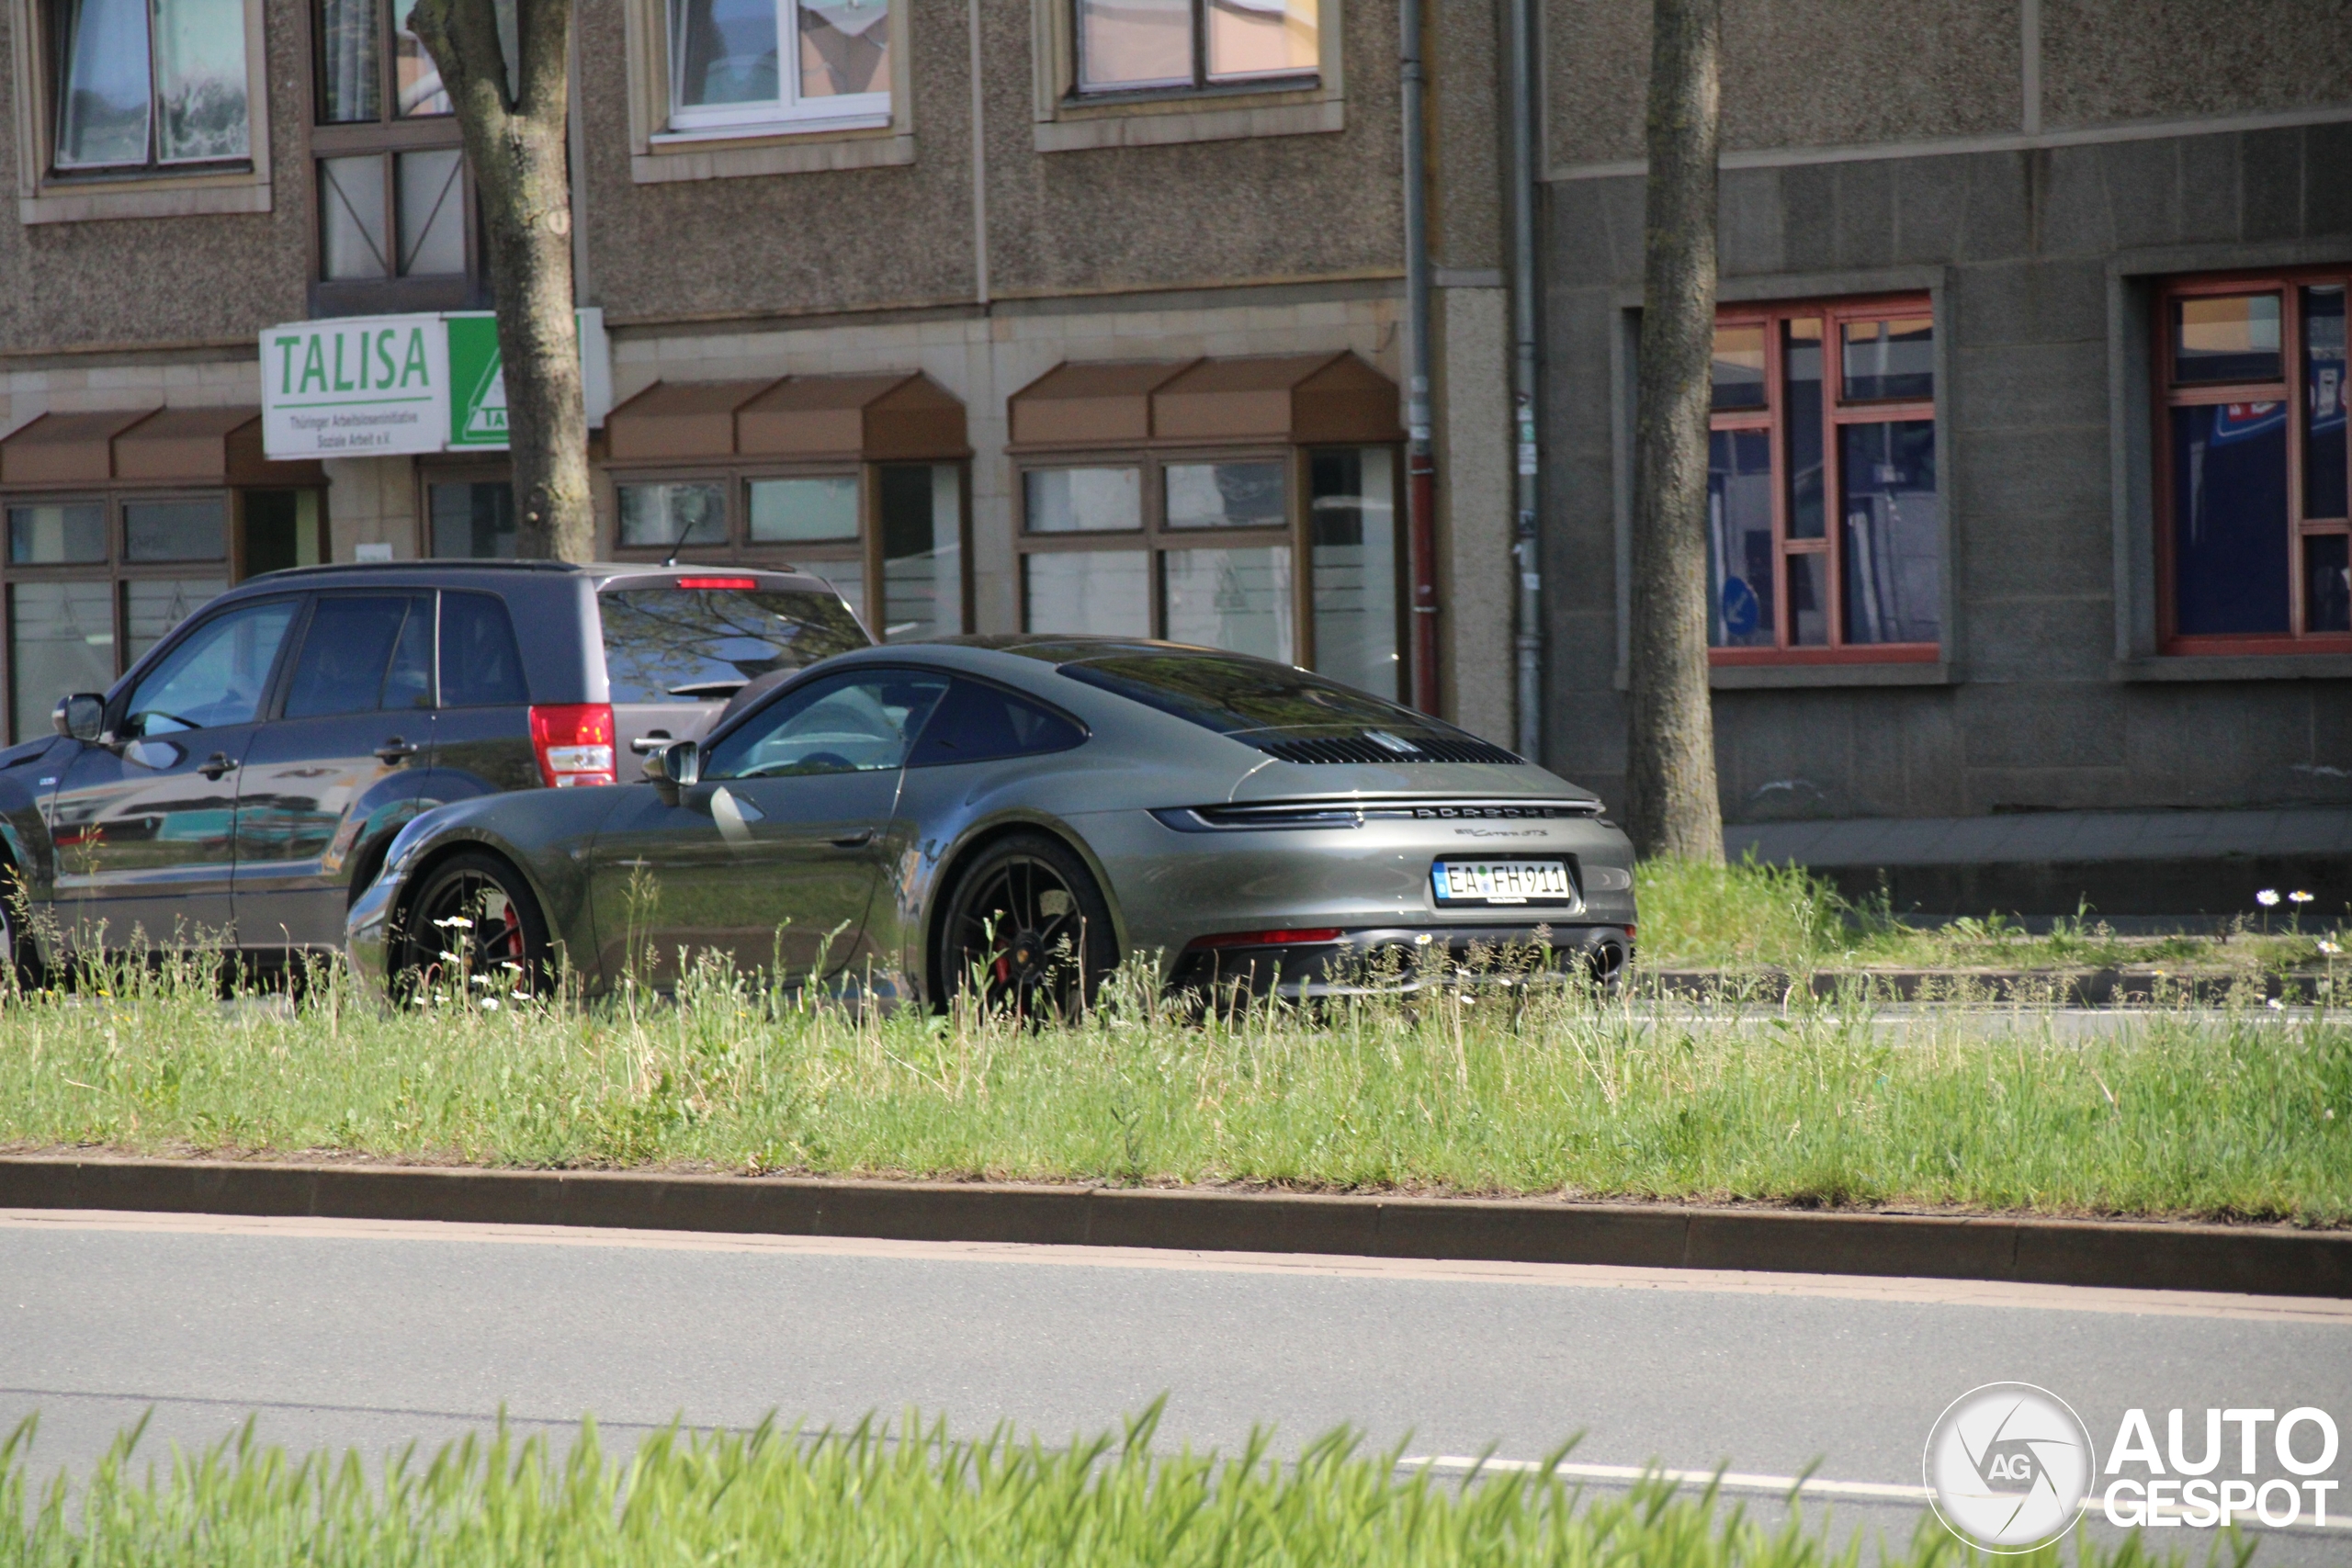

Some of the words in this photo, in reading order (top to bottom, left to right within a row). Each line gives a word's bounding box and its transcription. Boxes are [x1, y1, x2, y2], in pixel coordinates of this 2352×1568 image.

[274, 326, 430, 395] TALISA
[349, 433, 374, 446] Arbeit
[1416, 807, 1556, 819] PORSCHE
[1447, 866, 1479, 894] EA
